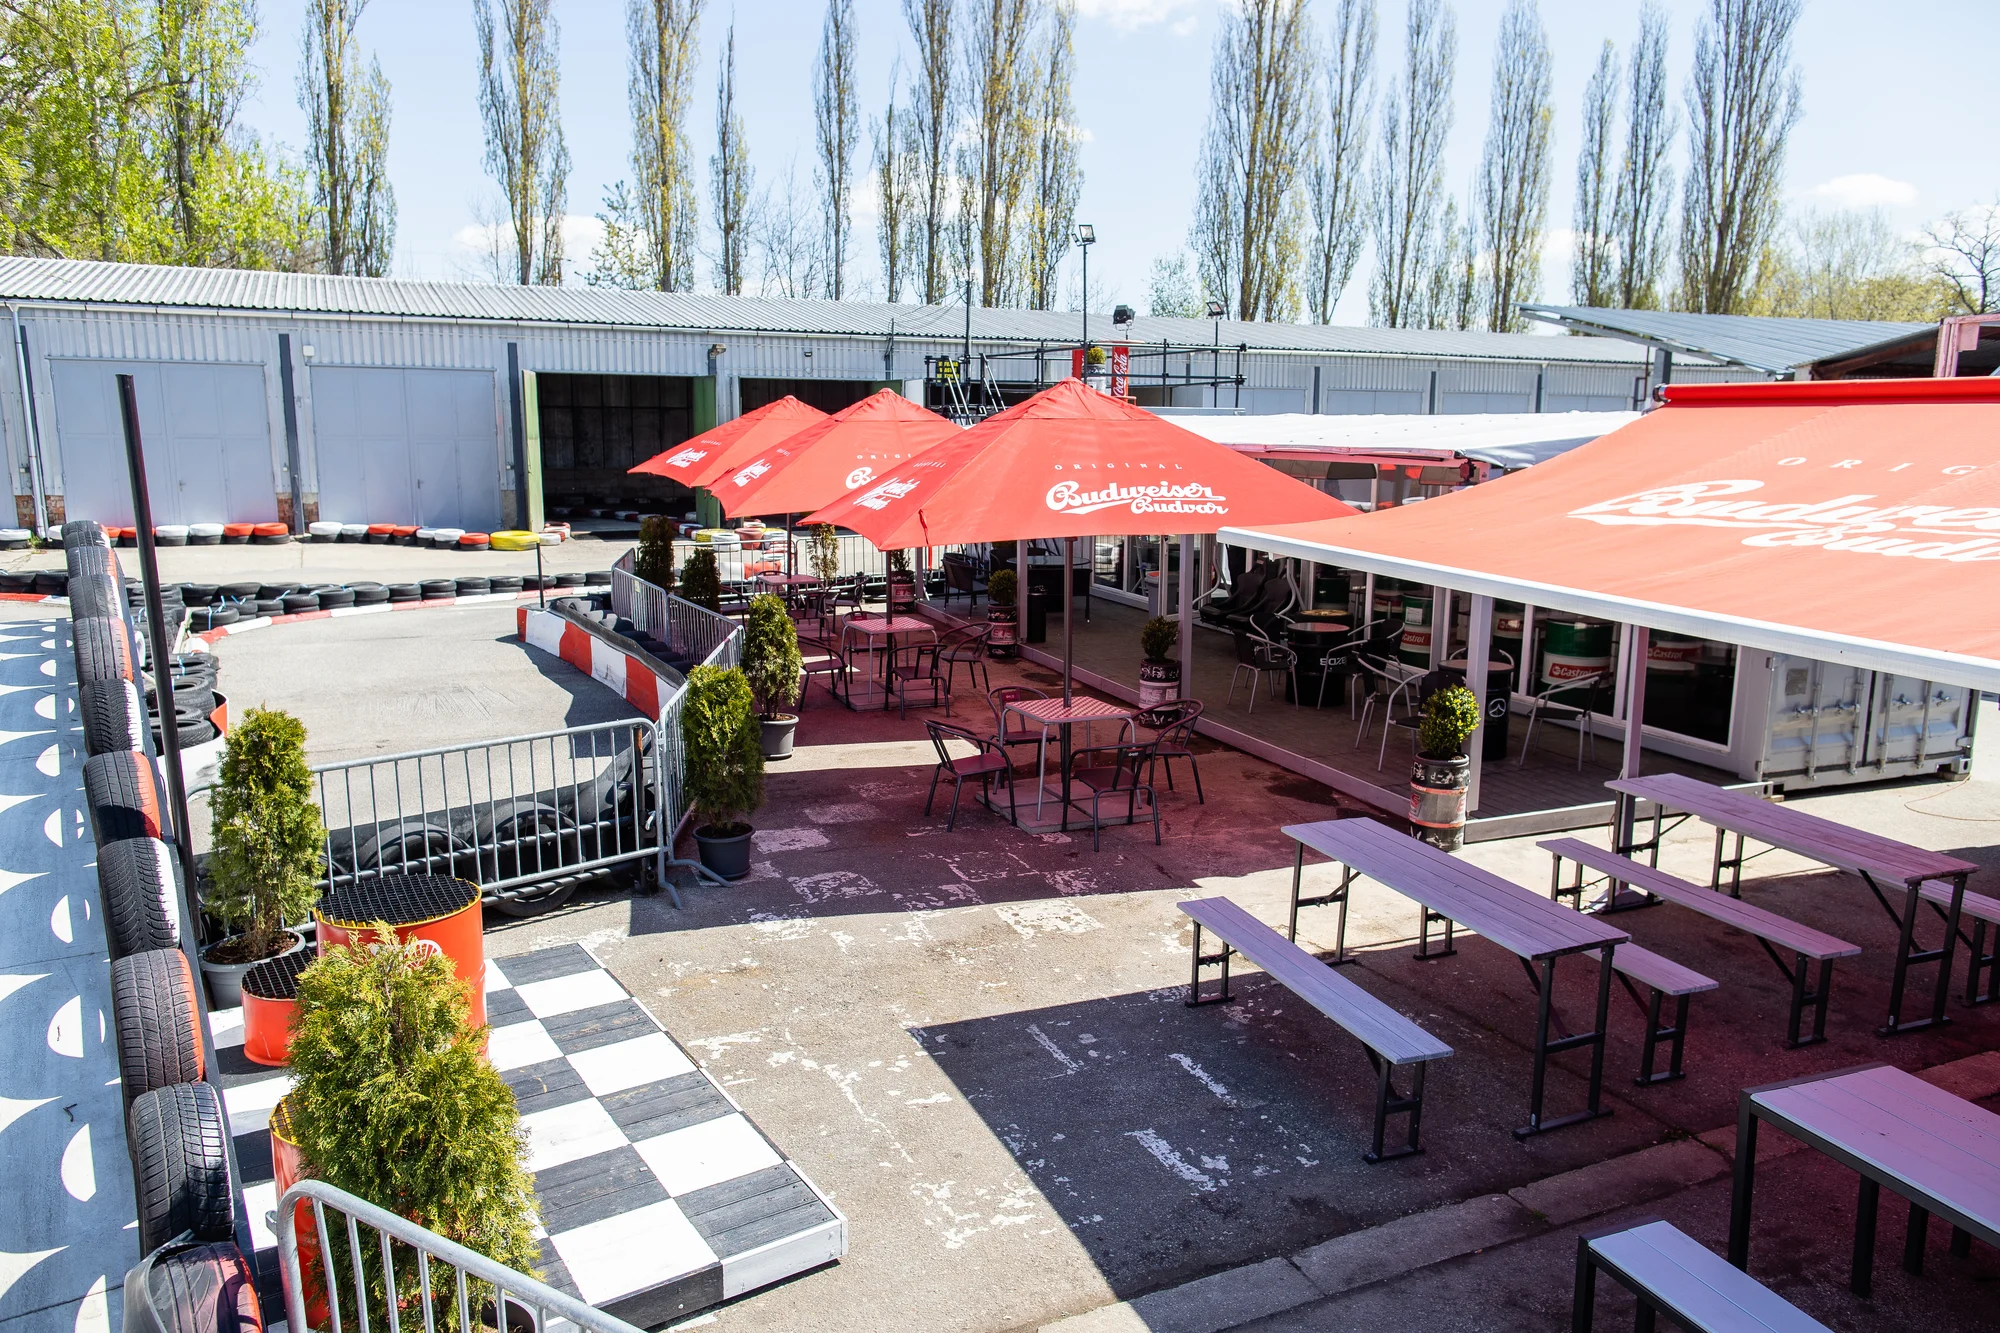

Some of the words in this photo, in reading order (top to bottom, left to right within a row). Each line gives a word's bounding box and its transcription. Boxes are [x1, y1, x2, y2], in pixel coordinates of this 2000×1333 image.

[1113, 351, 1128, 397] CocaCola
[1054, 462, 1183, 470] ORIGINAL
[1777, 456, 1977, 475] ORIG
[1046, 480, 1226, 512] Budweiser
[1131, 496, 1229, 514] Budvar
[1653, 649, 1683, 659] Castrol
[1561, 667, 1592, 677] Castrol
